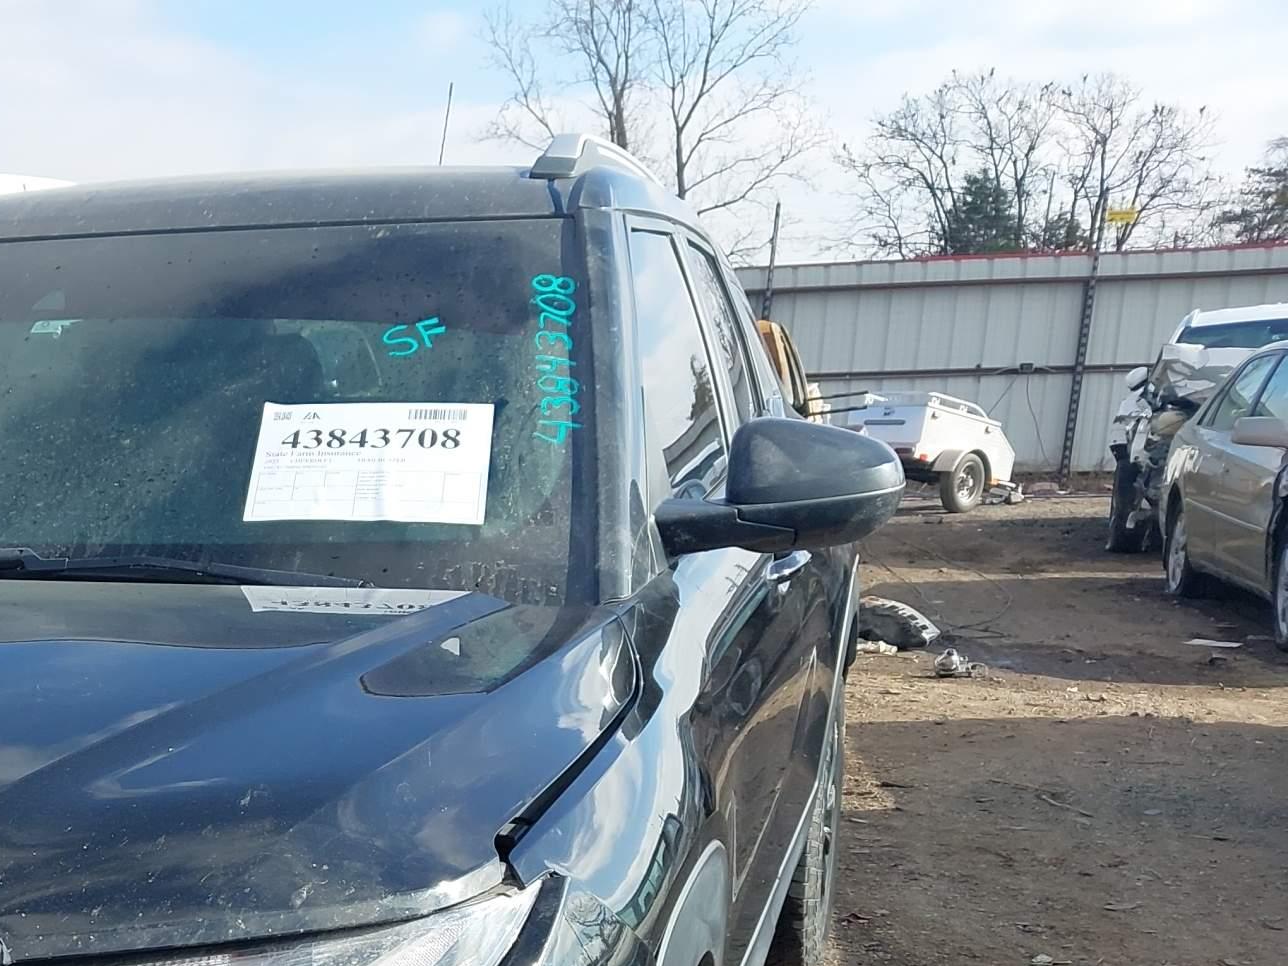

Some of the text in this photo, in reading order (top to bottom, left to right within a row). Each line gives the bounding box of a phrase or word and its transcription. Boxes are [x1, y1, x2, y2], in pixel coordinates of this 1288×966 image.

[382, 317, 446, 357] SF
[531, 274, 583, 445] 43843708
[281, 428, 461, 449] 43843708
